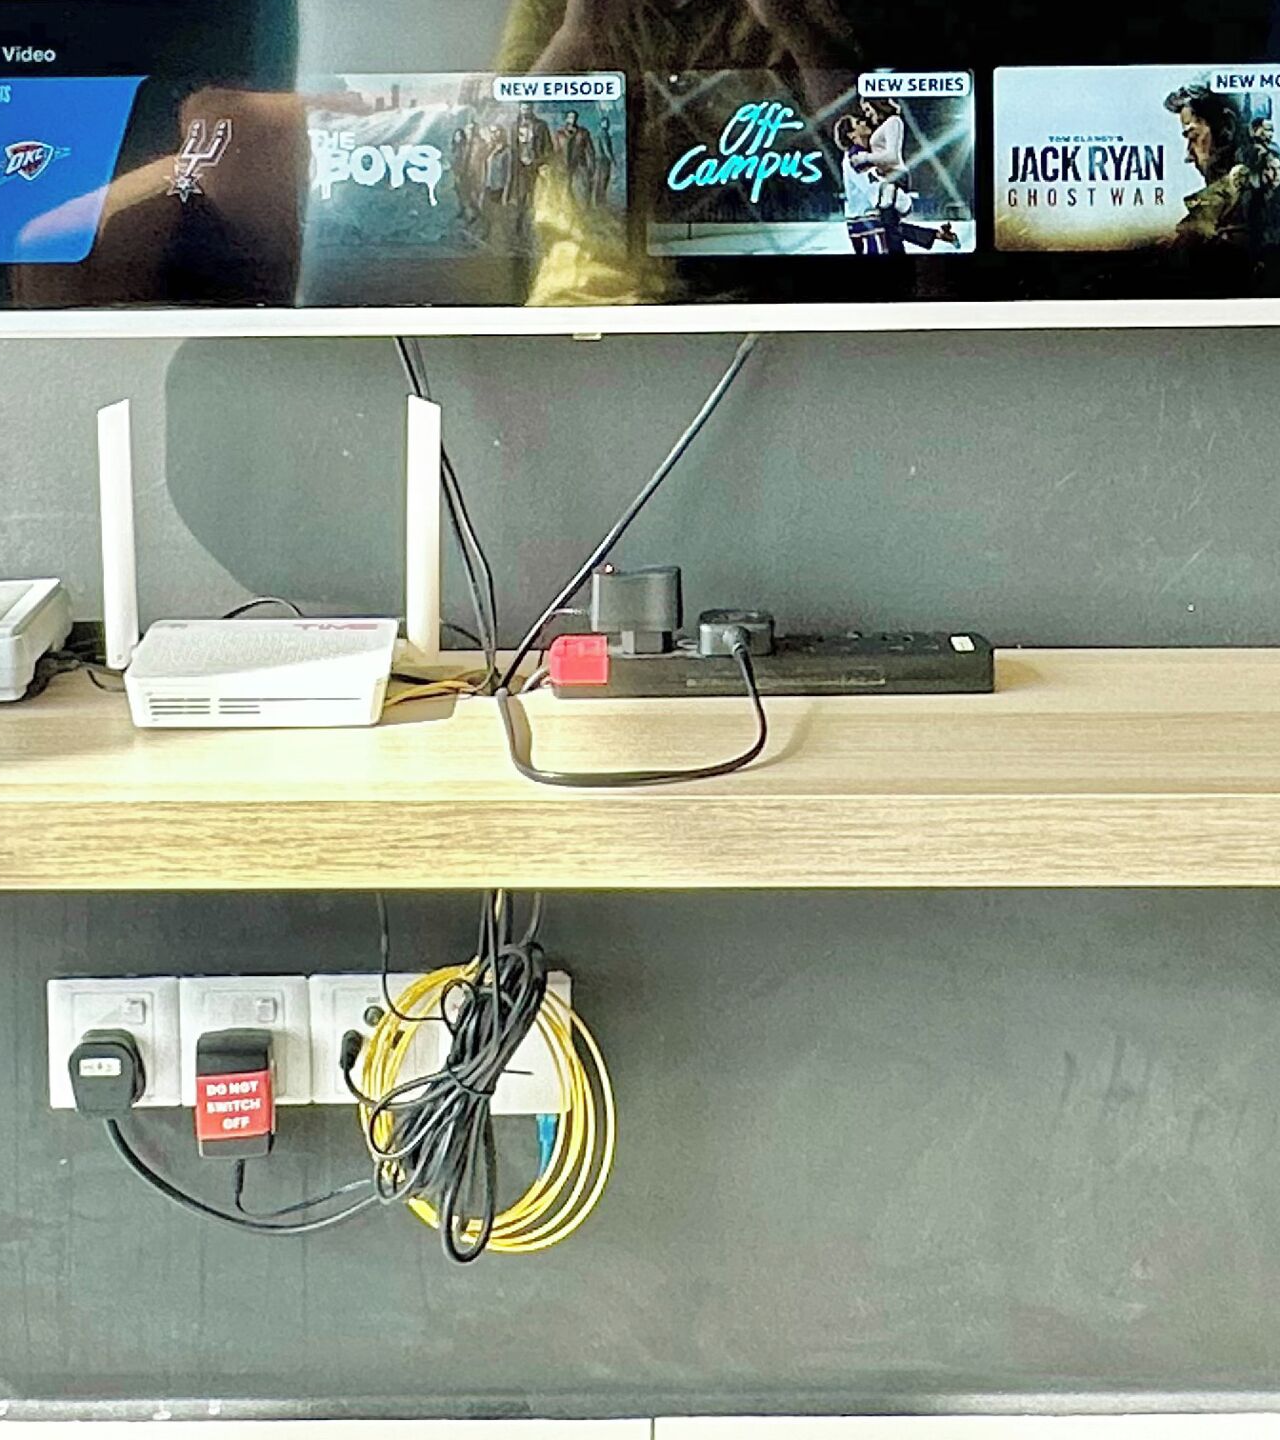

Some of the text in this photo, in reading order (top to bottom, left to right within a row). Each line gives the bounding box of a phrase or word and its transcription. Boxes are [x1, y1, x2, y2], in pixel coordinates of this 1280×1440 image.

[2, 46, 57, 63] Video
[500, 80, 616, 97] NEW EPISODE
[864, 77, 965, 93] NEW SERIES
[1216, 74, 1255, 89] NEW
[719, 101, 804, 157] Off
[308, 128, 356, 151] THE
[1007, 144, 1165, 183] JACK RYAN
[314, 143, 443, 207] BOYS
[667, 144, 824, 204] Campus
[1007, 186, 1165, 208] GHOST WAR
[205, 1079, 260, 1097] DO NOT
[205, 1097, 262, 1115] SWITCH
[222, 1115, 251, 1131] OFF
